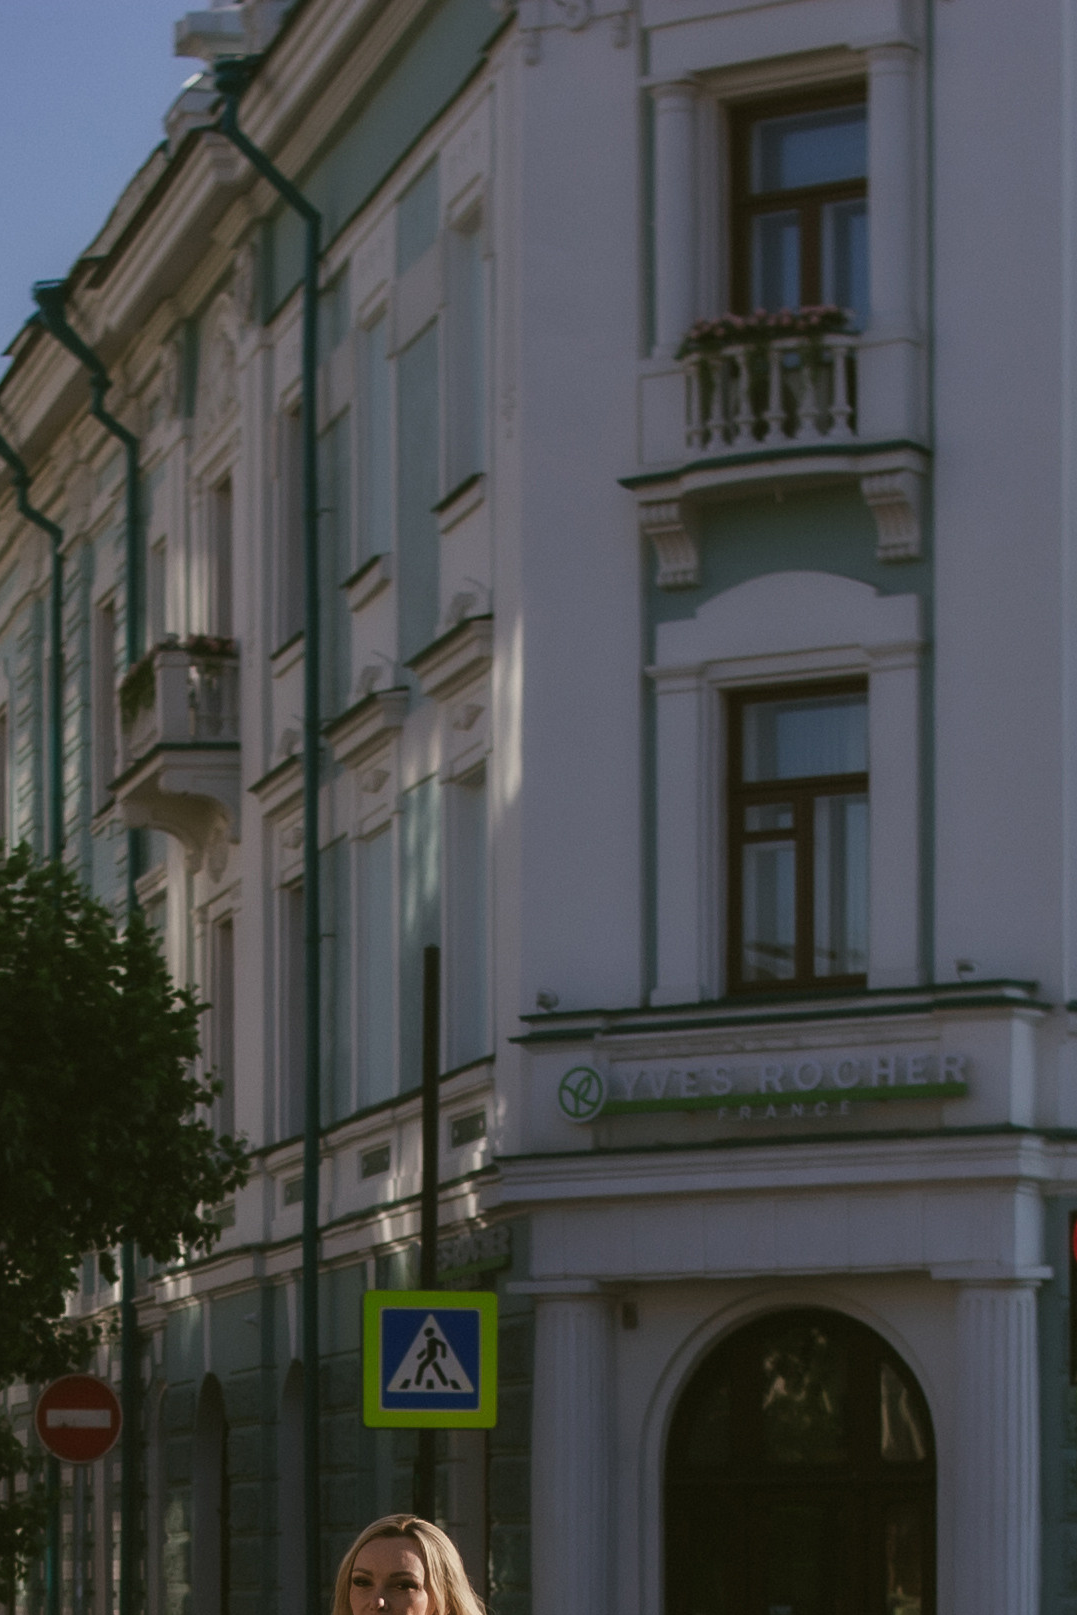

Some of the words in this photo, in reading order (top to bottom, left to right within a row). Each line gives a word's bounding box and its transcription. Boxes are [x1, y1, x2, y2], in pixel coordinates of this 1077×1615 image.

[621, 1065, 733, 1100] YVES
[758, 1054, 966, 1094] ROCHER
[717, 1100, 853, 1121] FRANCE
